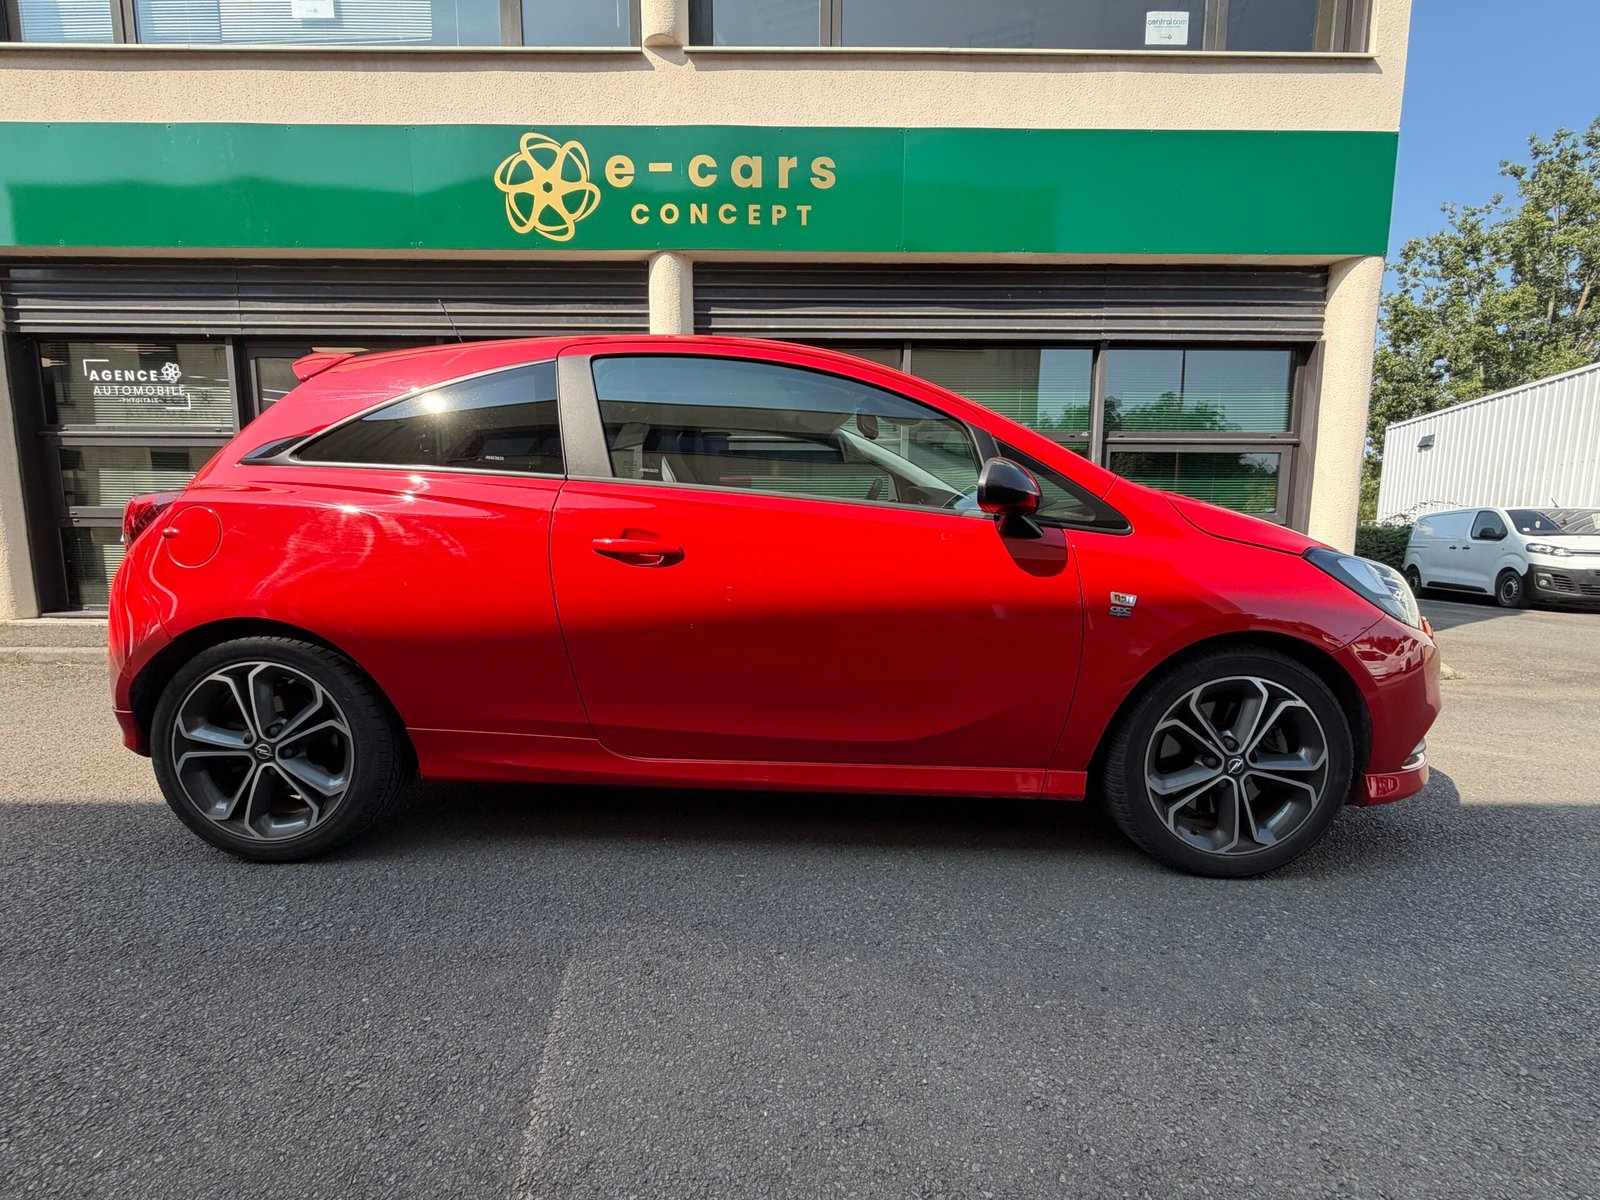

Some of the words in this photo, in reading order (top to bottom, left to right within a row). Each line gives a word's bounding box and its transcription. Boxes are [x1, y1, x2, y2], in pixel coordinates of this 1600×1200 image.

[604, 154, 836, 189] e-cars
[630, 203, 812, 226] CONCEPT
[89, 369, 158, 381] AGENCE
[93, 385, 185, 396] AUTOMOBILE
